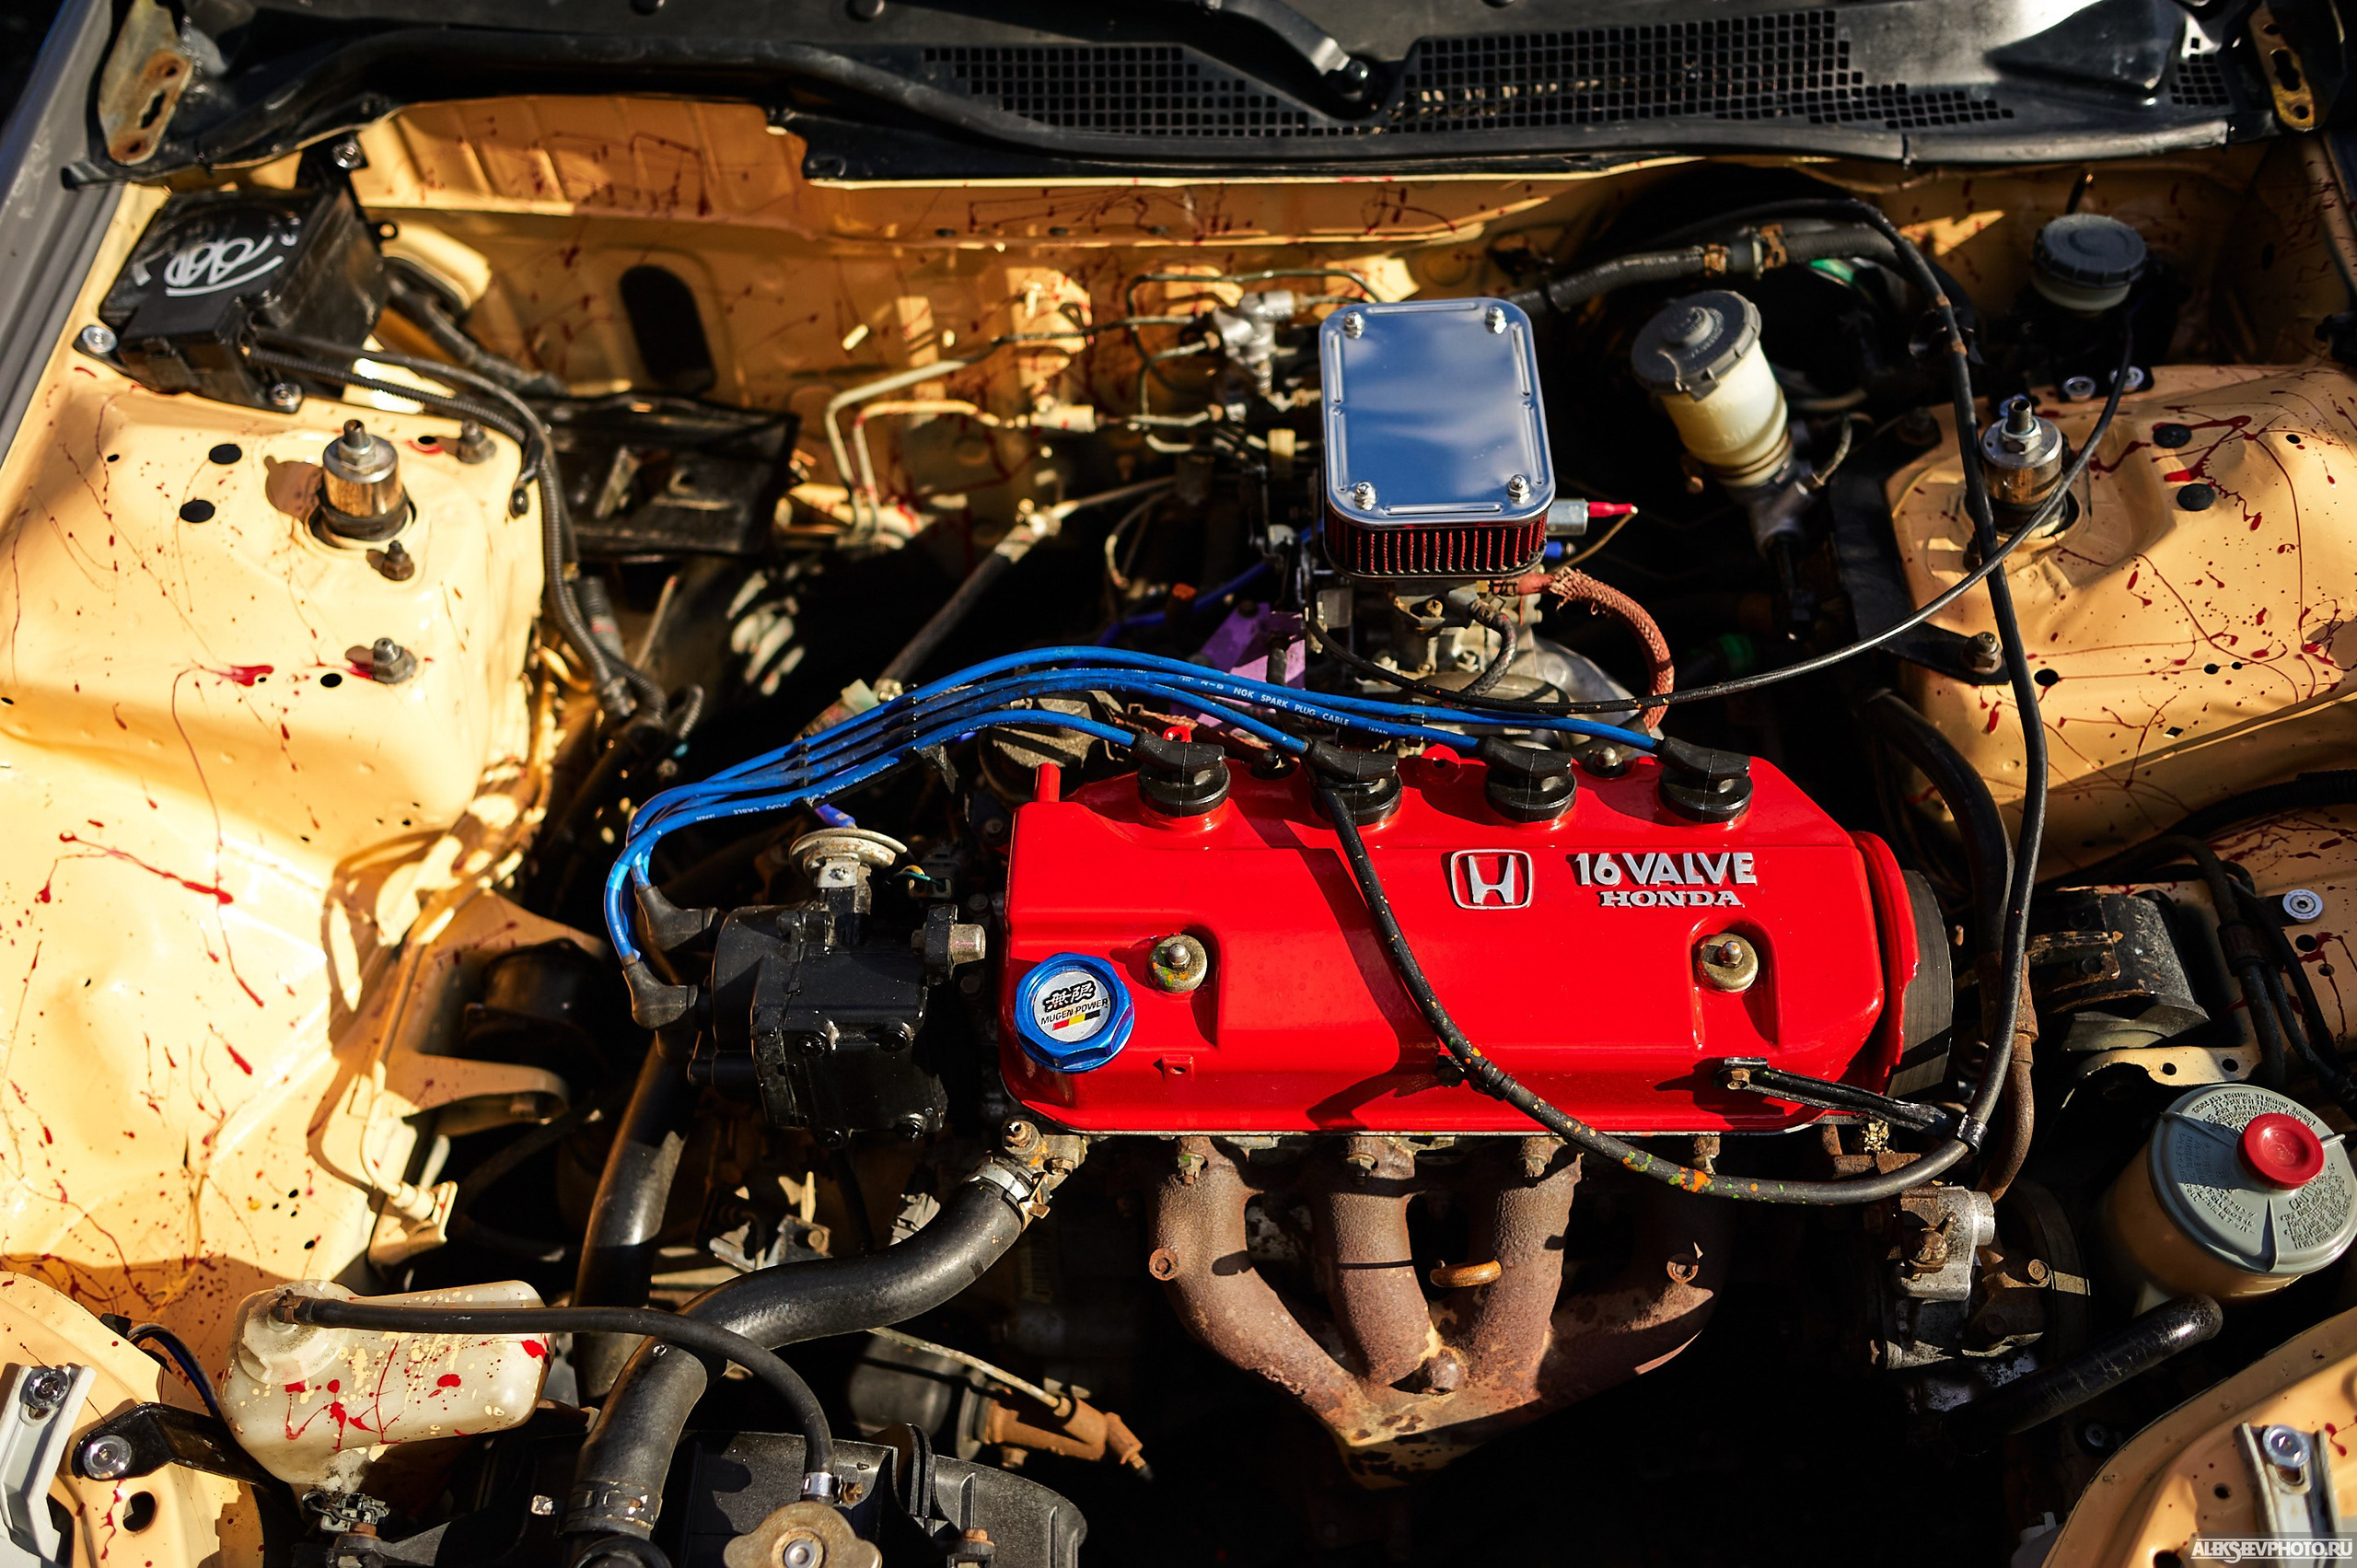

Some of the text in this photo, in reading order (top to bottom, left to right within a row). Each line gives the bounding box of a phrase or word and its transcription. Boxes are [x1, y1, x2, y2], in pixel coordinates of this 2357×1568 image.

[1234, 686, 1254, 700] NGK
[1260, 694, 1289, 709] SPARK
[1294, 703, 1317, 717] PLUG
[1322, 713, 1350, 726] CABLE
[1573, 852, 1758, 887] 16 VALVE
[1600, 889, 1746, 909] HONDA
[1040, 998, 1109, 1025] MUGEN POWER
[2289, 1181, 2316, 1210] CAUTI
